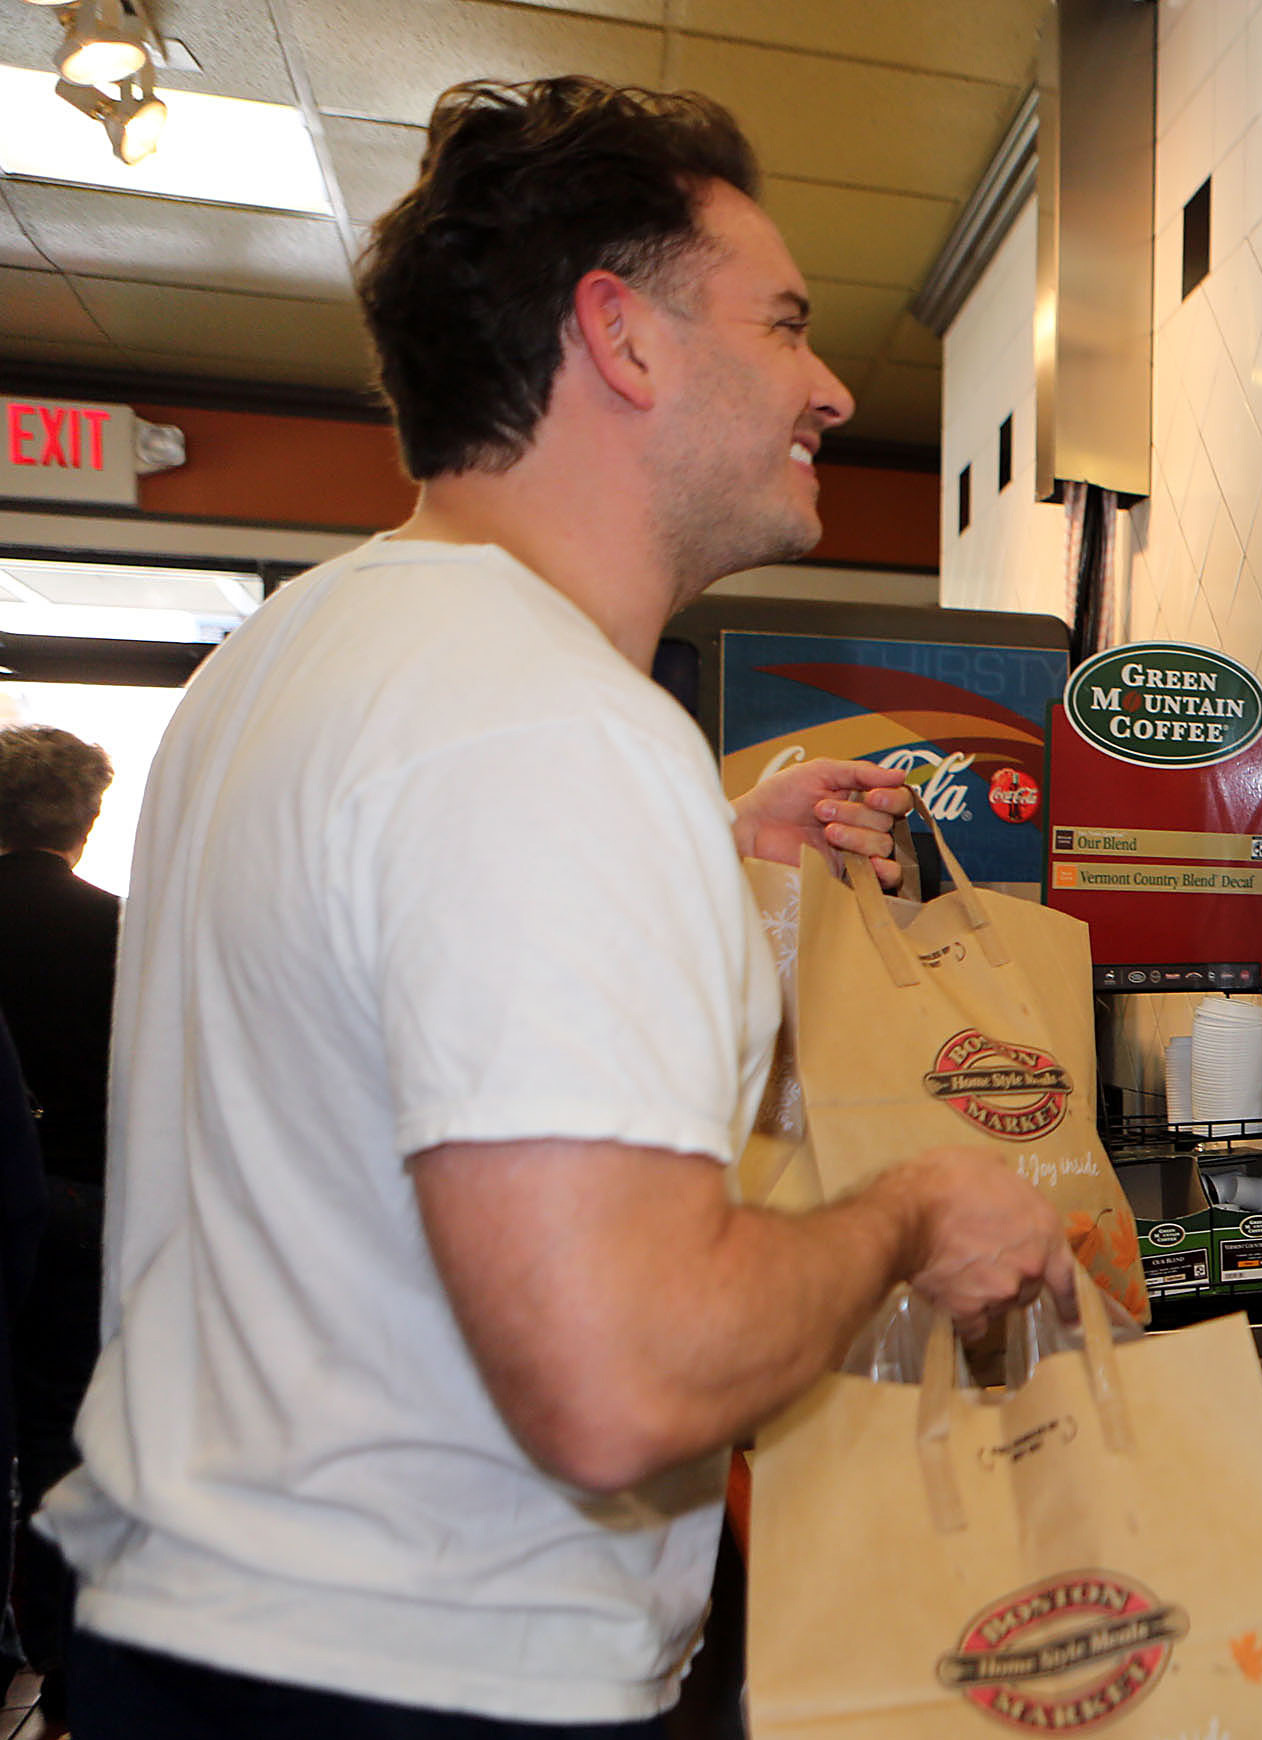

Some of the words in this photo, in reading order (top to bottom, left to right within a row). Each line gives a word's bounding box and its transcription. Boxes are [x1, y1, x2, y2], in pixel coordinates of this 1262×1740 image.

[8, 403, 112, 471] EXIT
[1120, 663, 1218, 692] GREEN
[1090, 686, 1246, 718] MOUNTAIN
[1109, 715, 1224, 743] COFFEE
[1077, 835, 1102, 849] Our
[1103, 836, 1137, 851] Blend
[1080, 871, 1130, 885] Vermont
[1133, 872, 1178, 890] Country
[1182, 873, 1215, 887] Blend
[1221, 875, 1256, 889] Decaf
[952, 1075, 992, 1091] Home
[992, 1072, 1023, 1090] Style
[966, 1096, 1060, 1133] MARKET
[980, 1583, 1129, 1645] BOSTON
[993, 1656, 1148, 1729] MARKET
